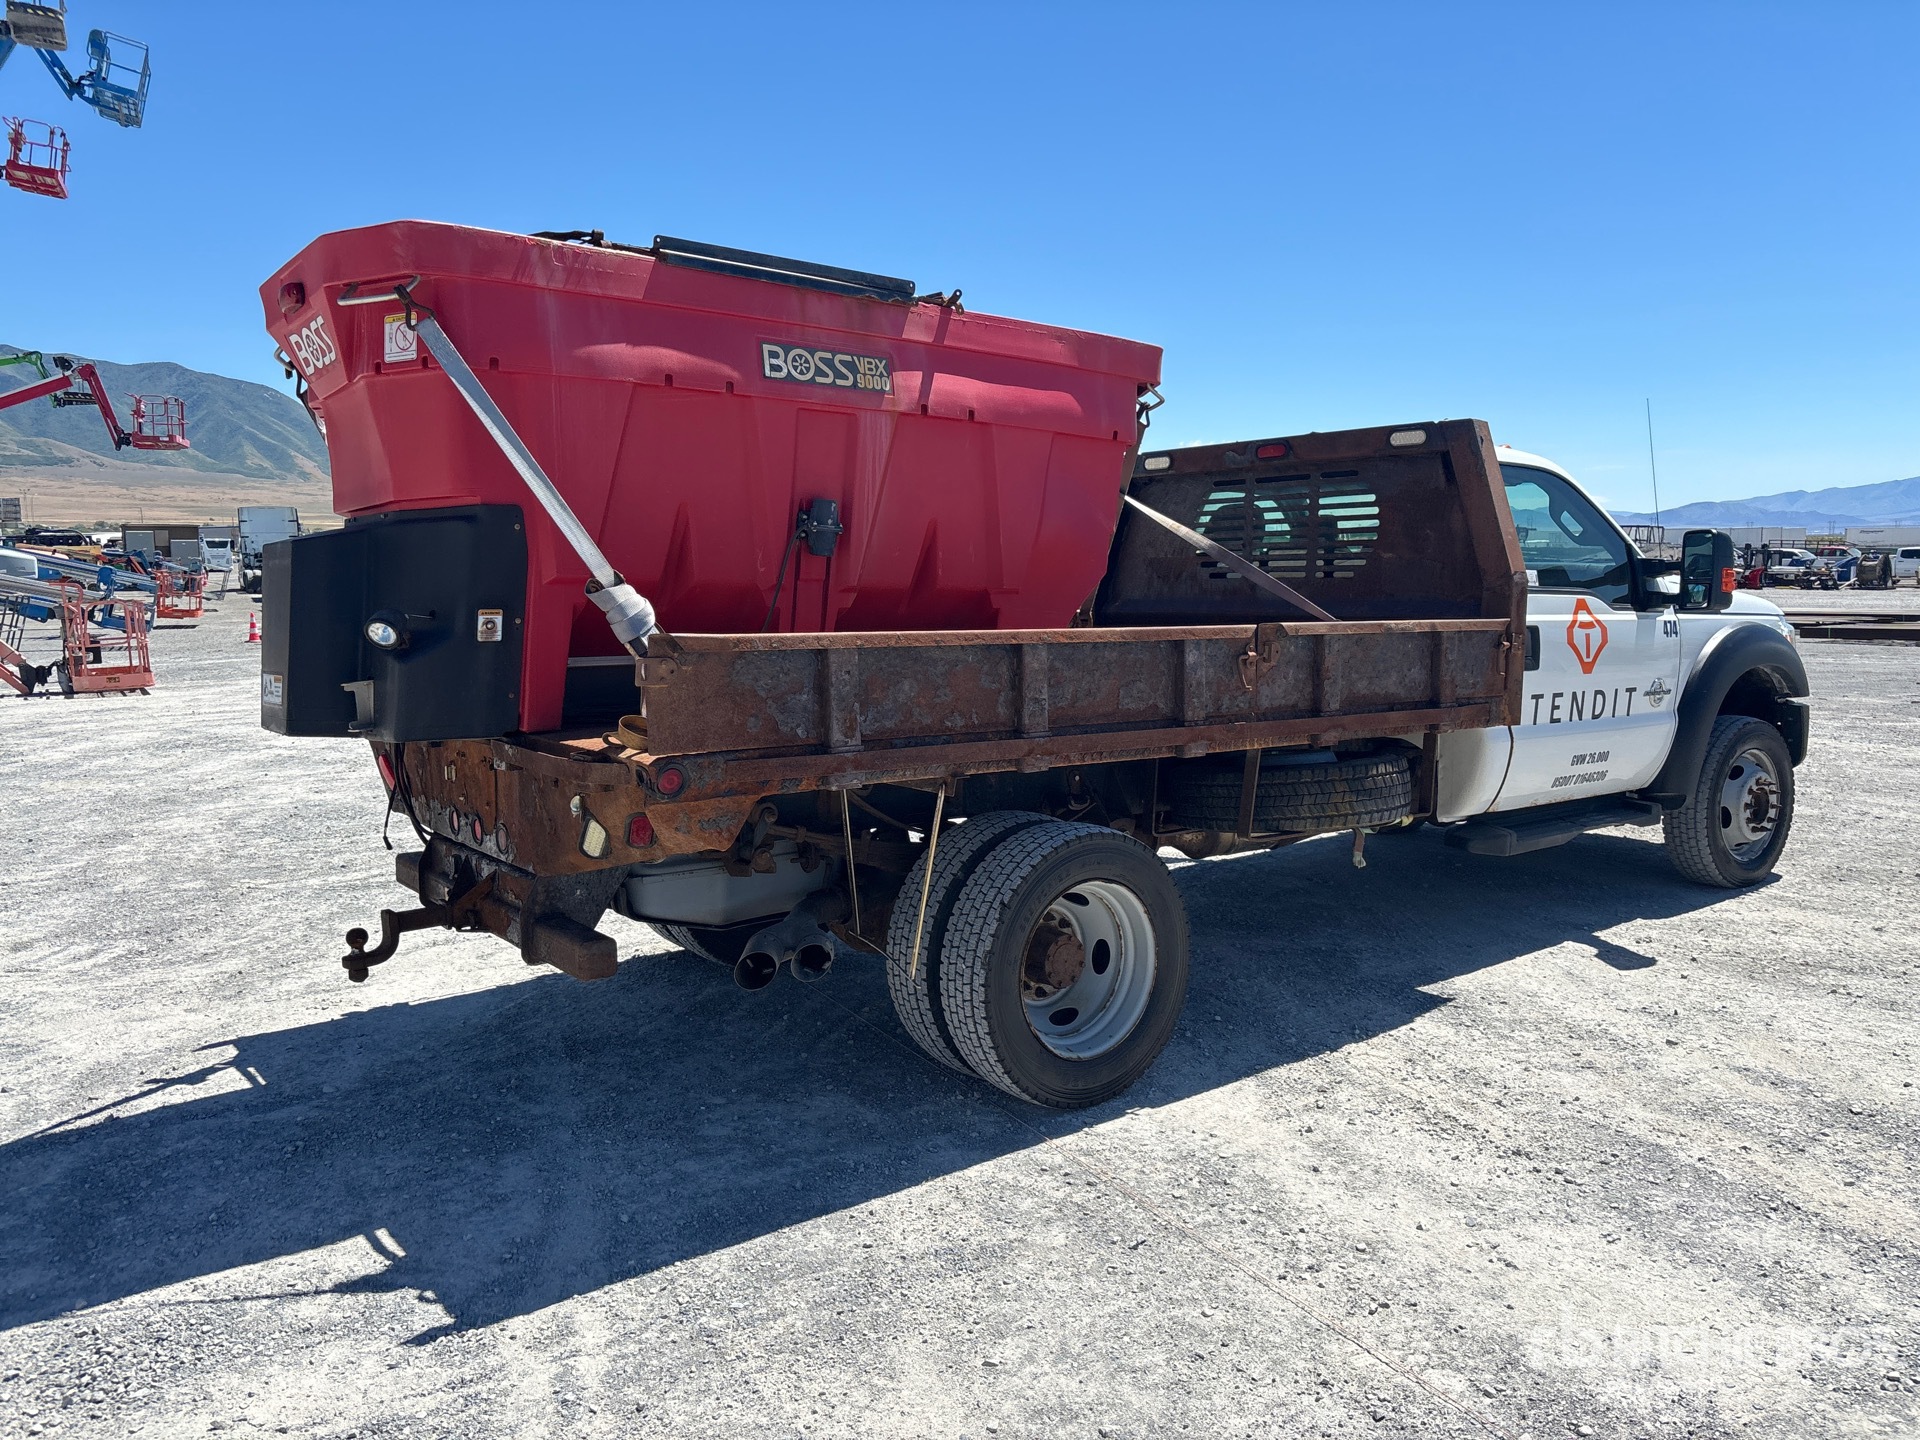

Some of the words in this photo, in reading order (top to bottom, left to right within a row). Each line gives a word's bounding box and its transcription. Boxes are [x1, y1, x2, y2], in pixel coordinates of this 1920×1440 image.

[289, 315, 336, 376] BOSS
[762, 344, 853, 386] BOSS
[853, 355, 888, 377] VBX
[856, 374, 890, 391] 9000
[1663, 620, 1679, 638] 474
[1530, 687, 1637, 726] TENDIT
[1570, 753, 1588, 767] GVW
[1551, 774, 1576, 789] USDOT
